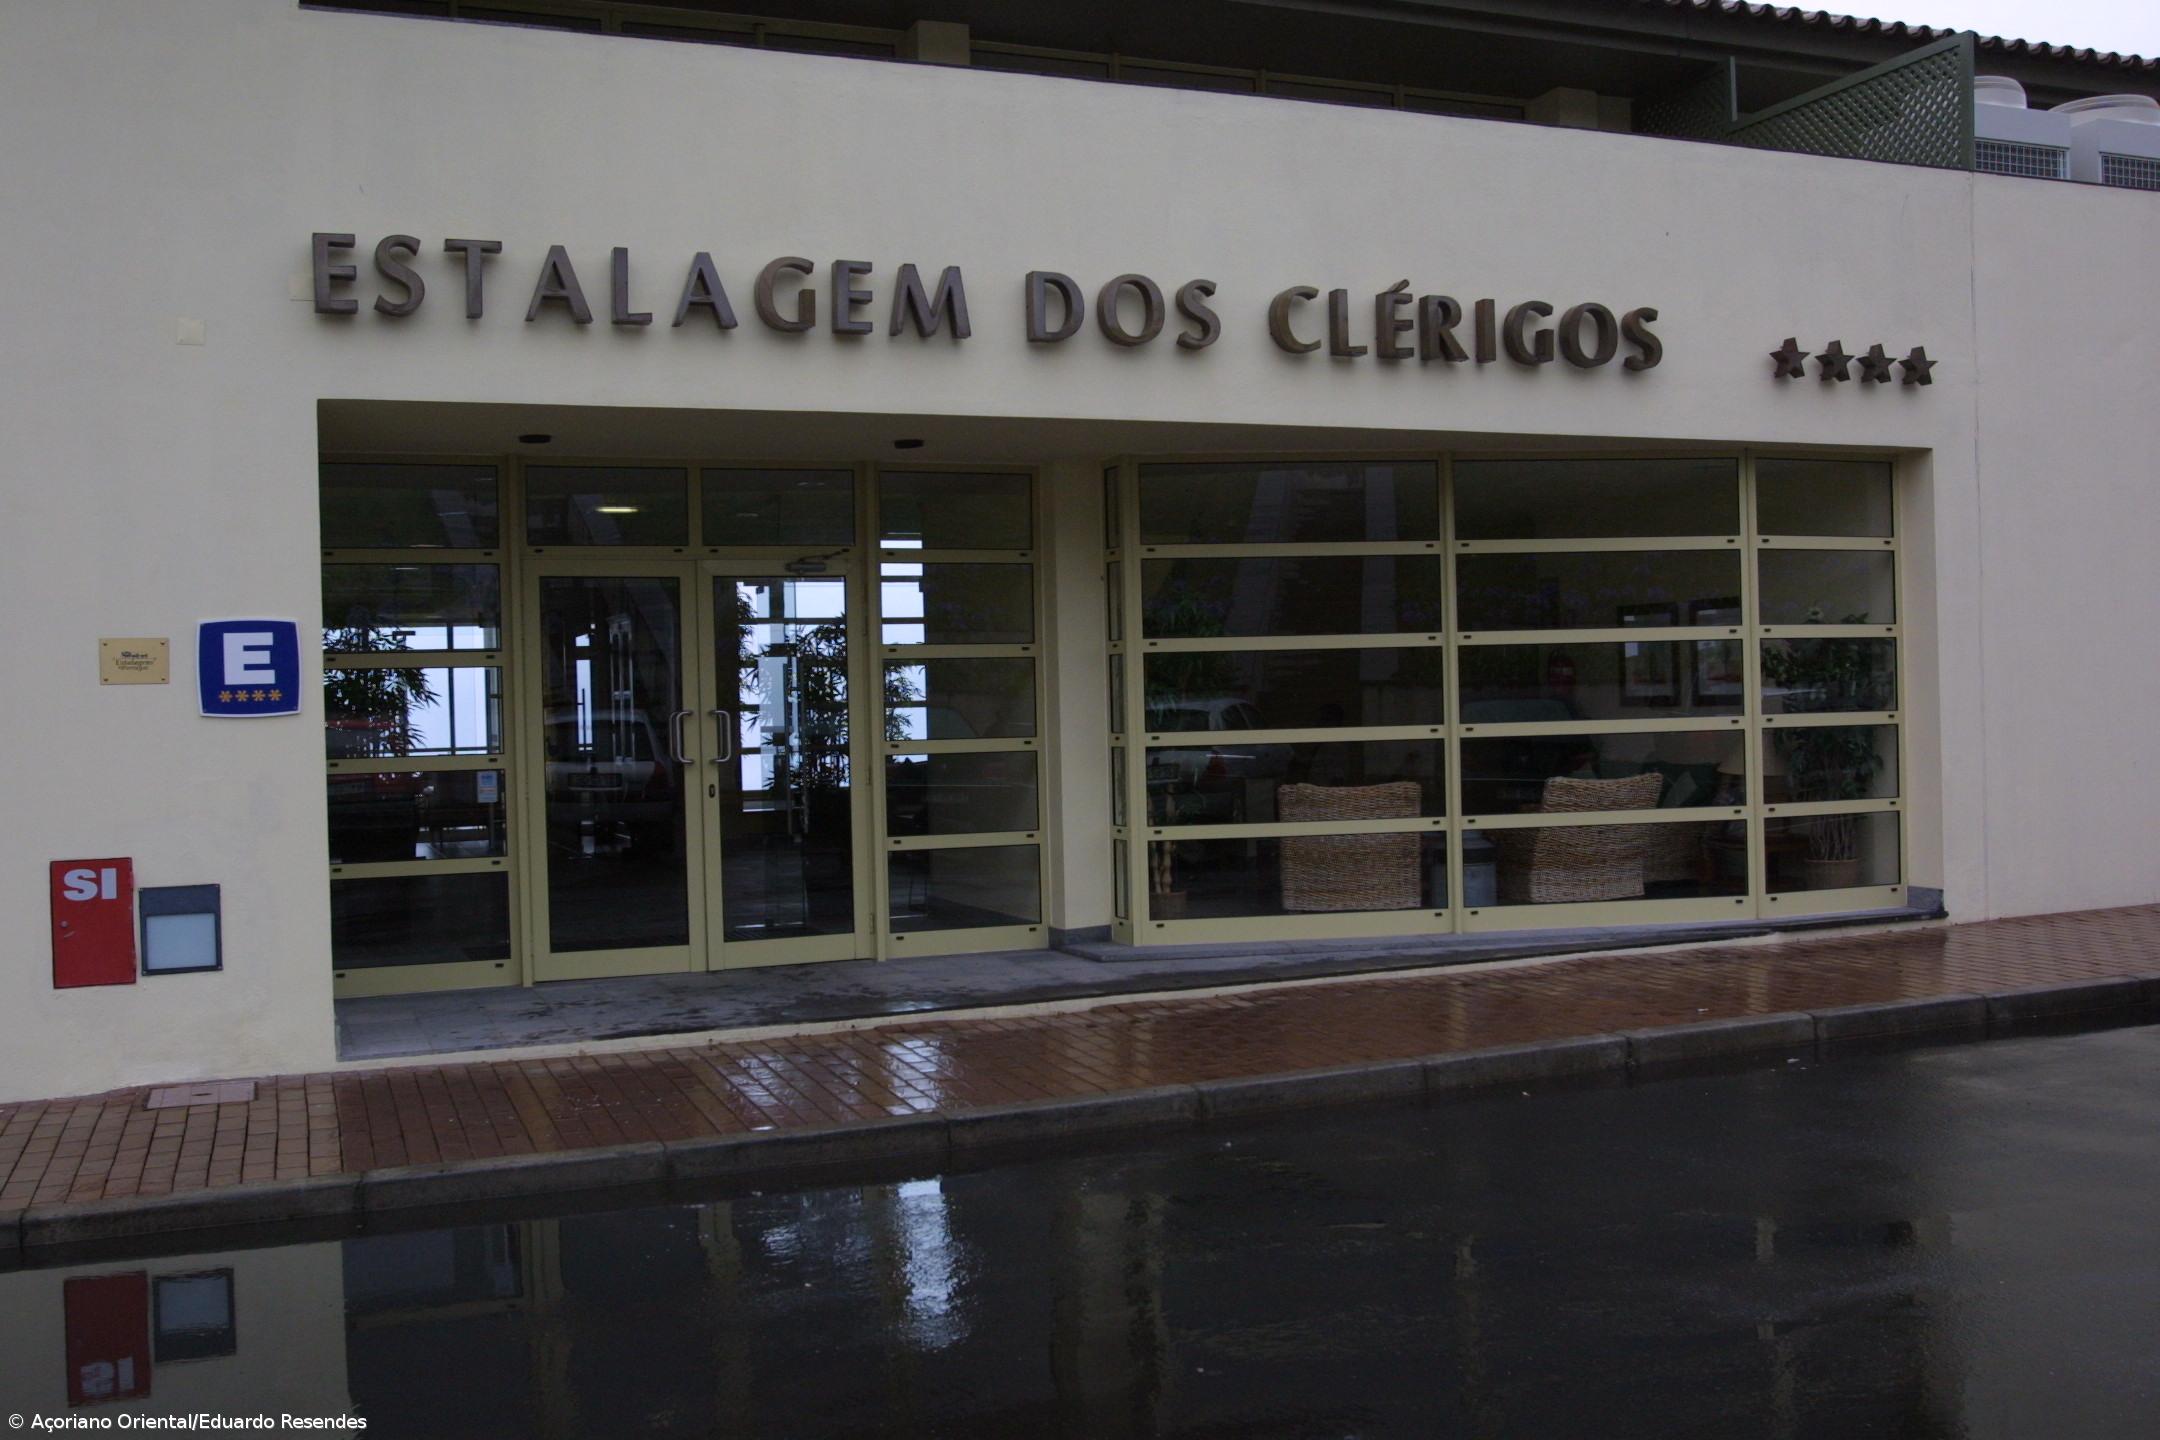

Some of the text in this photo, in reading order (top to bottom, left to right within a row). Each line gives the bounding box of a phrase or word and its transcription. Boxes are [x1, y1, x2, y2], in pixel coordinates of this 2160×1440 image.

[312, 232, 1663, 372] ESTALAGEM DOS CLÉRIGOS
[223, 632, 276, 685] E
[63, 867, 118, 901] SI
